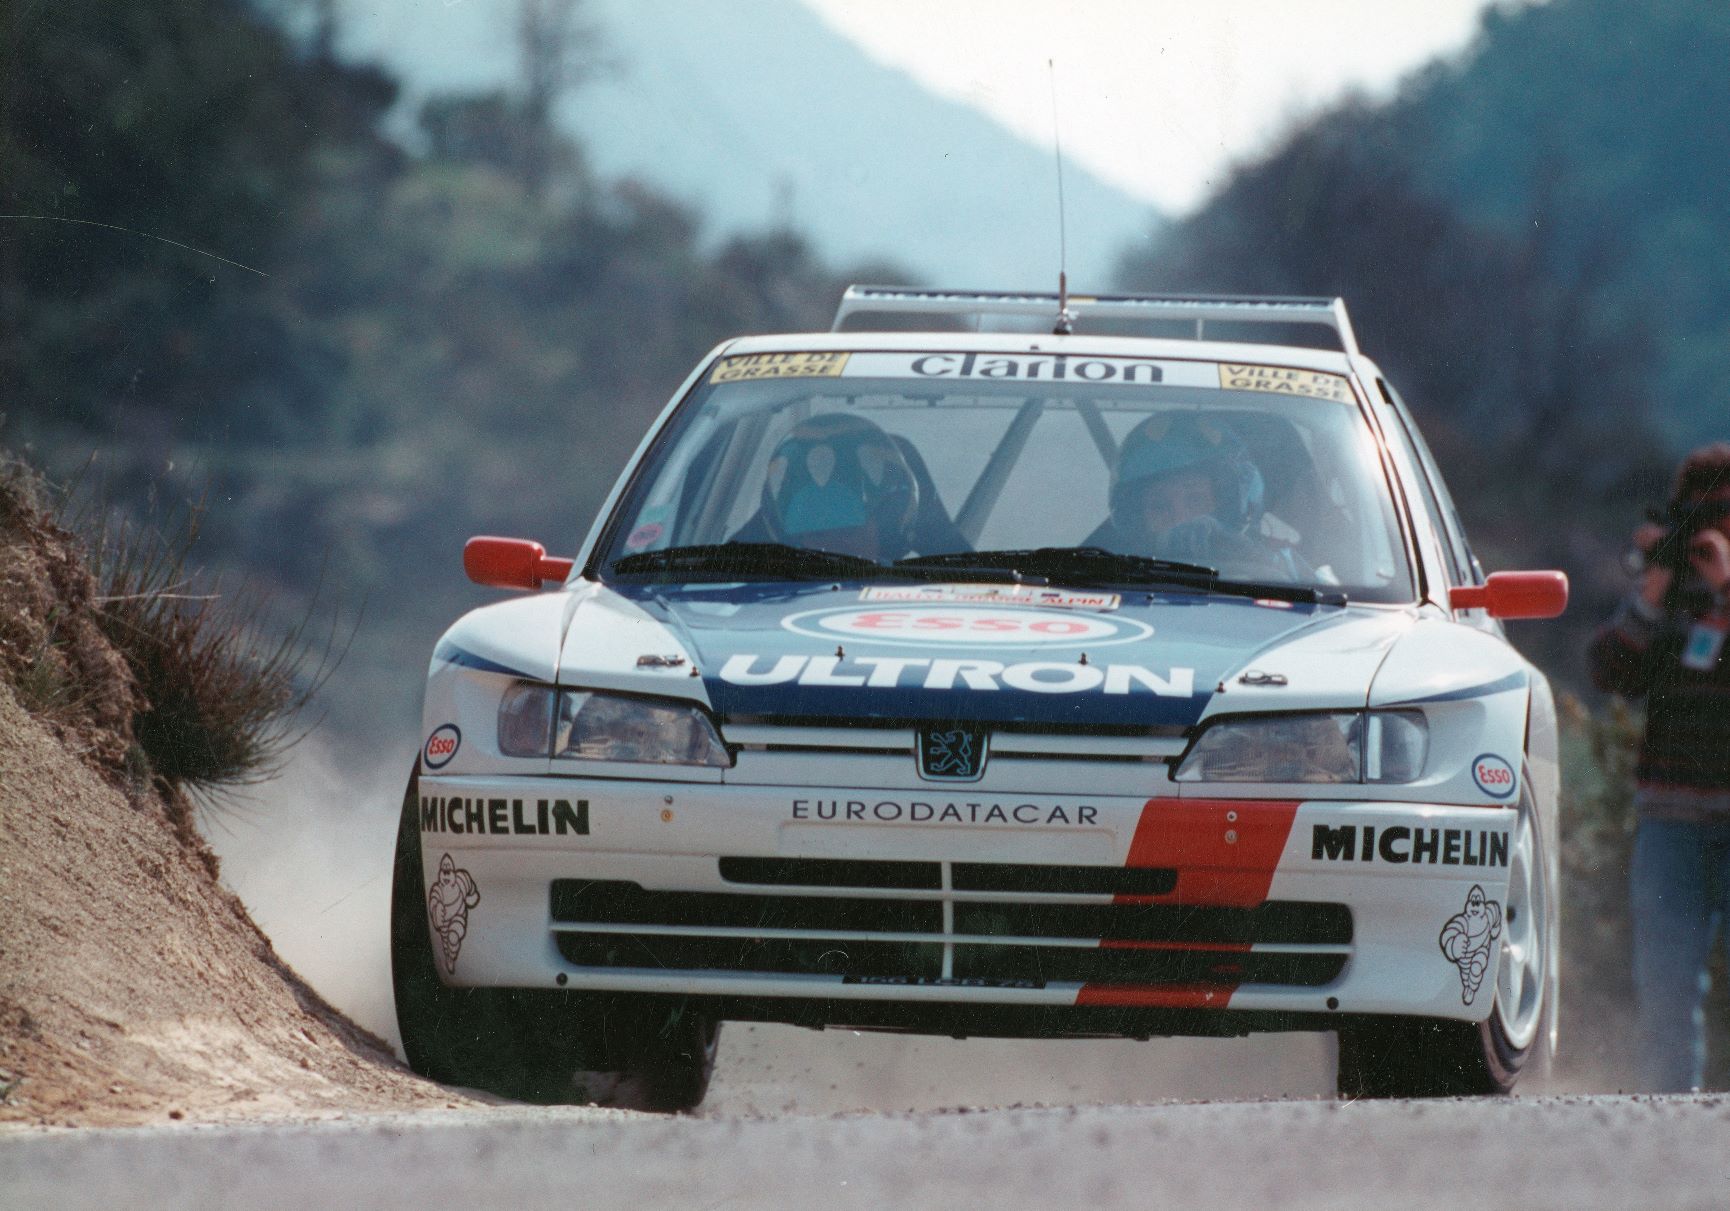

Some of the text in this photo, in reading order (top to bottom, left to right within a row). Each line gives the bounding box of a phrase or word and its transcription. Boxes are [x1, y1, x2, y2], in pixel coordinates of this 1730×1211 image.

[720, 364, 835, 380] GRASSE
[911, 352, 1163, 383] Clarion
[1227, 366, 1298, 381] VILLE
[1229, 378, 1344, 399] GRASSE
[719, 653, 1195, 698] ULTRON
[421, 796, 590, 835] MICHELIN
[792, 799, 1099, 826] EURODATACAR
[1311, 824, 1509, 868] MICHELIN
